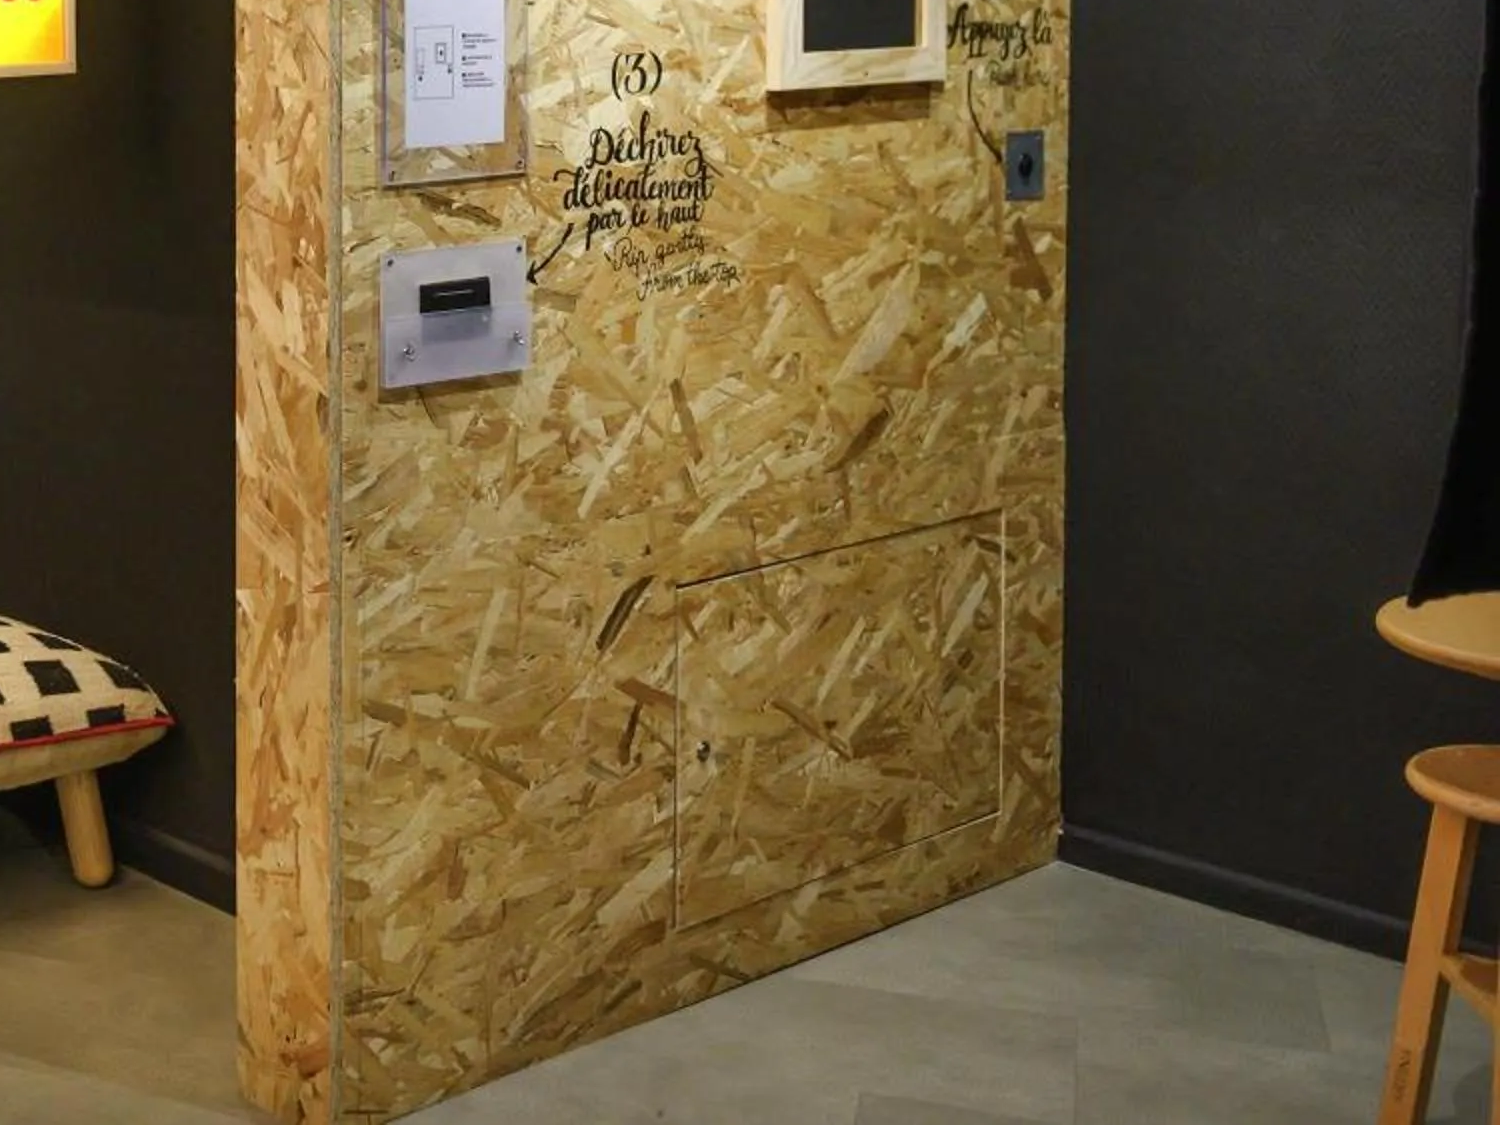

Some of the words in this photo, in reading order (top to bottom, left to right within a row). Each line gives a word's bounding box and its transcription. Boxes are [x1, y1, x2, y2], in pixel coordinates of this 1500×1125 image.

[947, 1, 1033, 62] Appuyez
[612, 49, 663, 102] (3)
[584, 110, 724, 177] Déchirez
[553, 164, 715, 211] délicatement
[586, 210, 626, 251] par
[630, 203, 651, 228] le
[656, 200, 706, 233] haut
